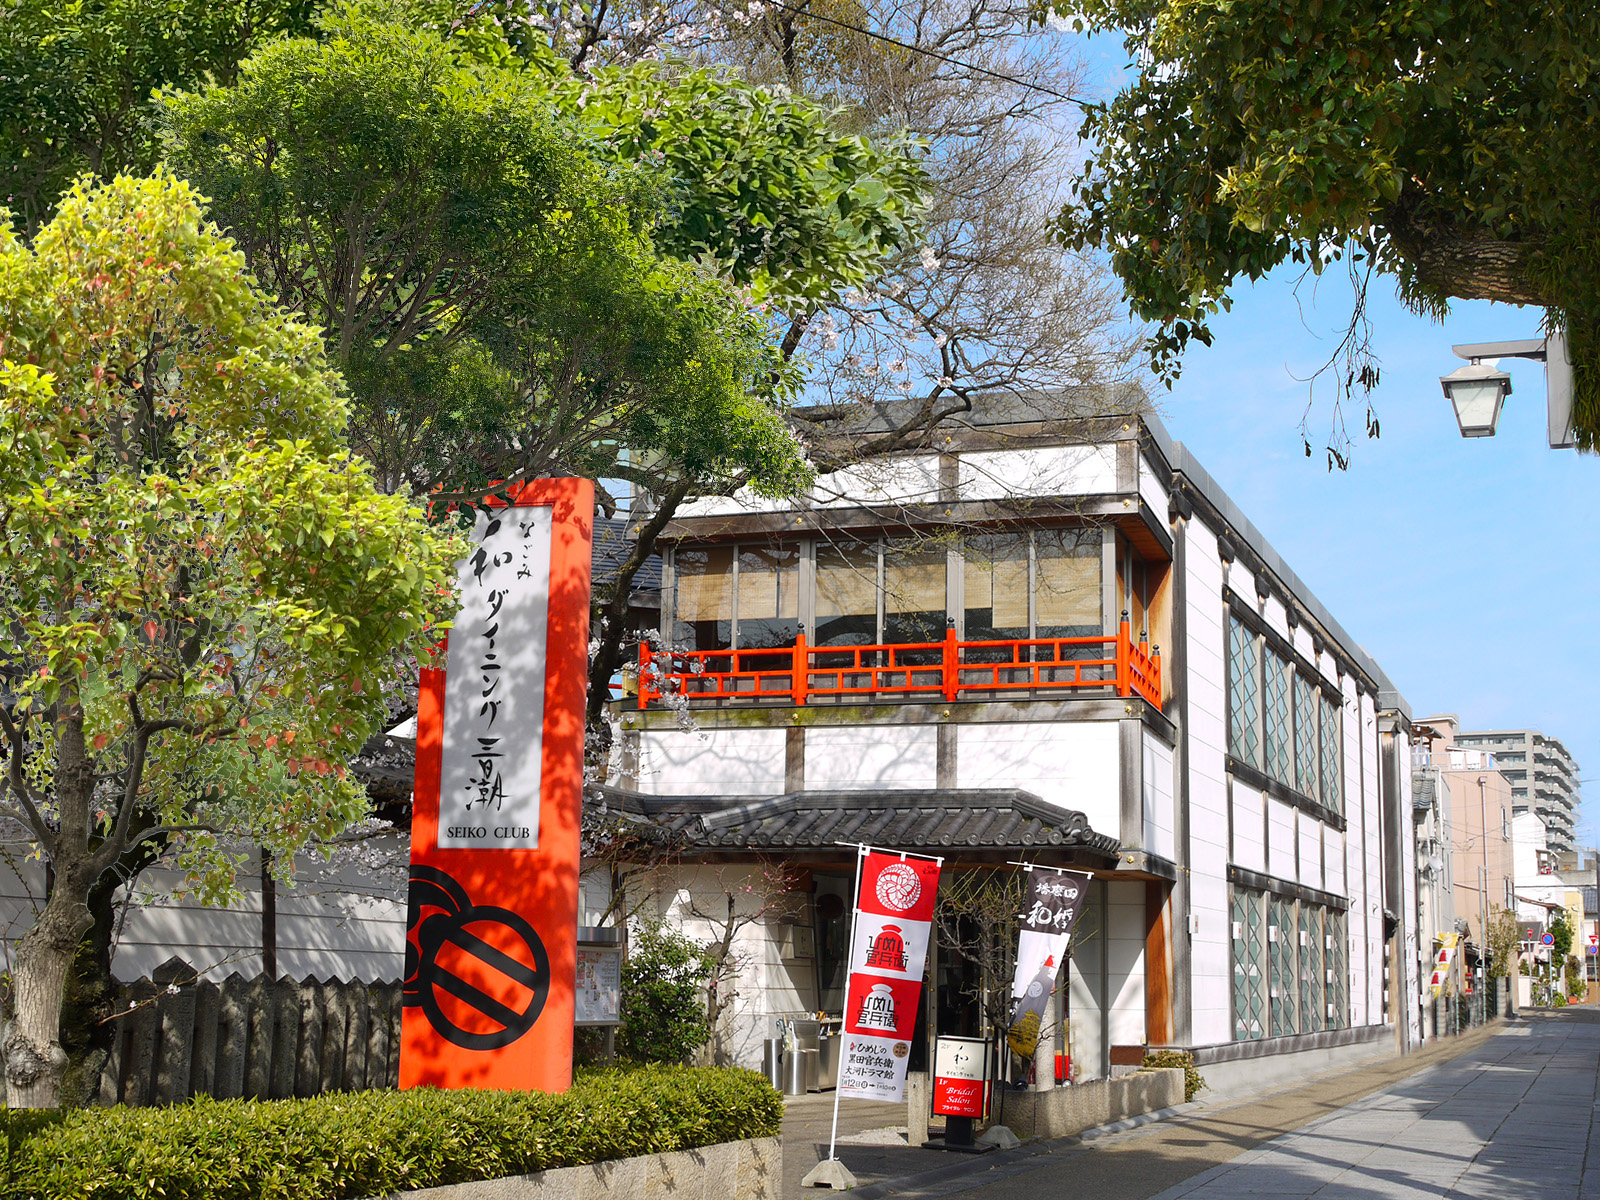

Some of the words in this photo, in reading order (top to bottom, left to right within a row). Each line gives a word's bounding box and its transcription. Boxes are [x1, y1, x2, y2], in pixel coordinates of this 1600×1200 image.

[447, 826, 487, 839] SEIKO
[493, 826, 530, 839] CLUB
[866, 949, 909, 969] 官兵衛
[857, 1009, 899, 1028] 官兵衛
[857, 1043, 887, 1054] ひめじの
[849, 1054, 894, 1068] 黒田官兵衛
[845, 1066, 894, 1079] 大河ドラマ館
[946, 1086, 977, 1096] Bridal
[946, 1096, 971, 1104] Salon
